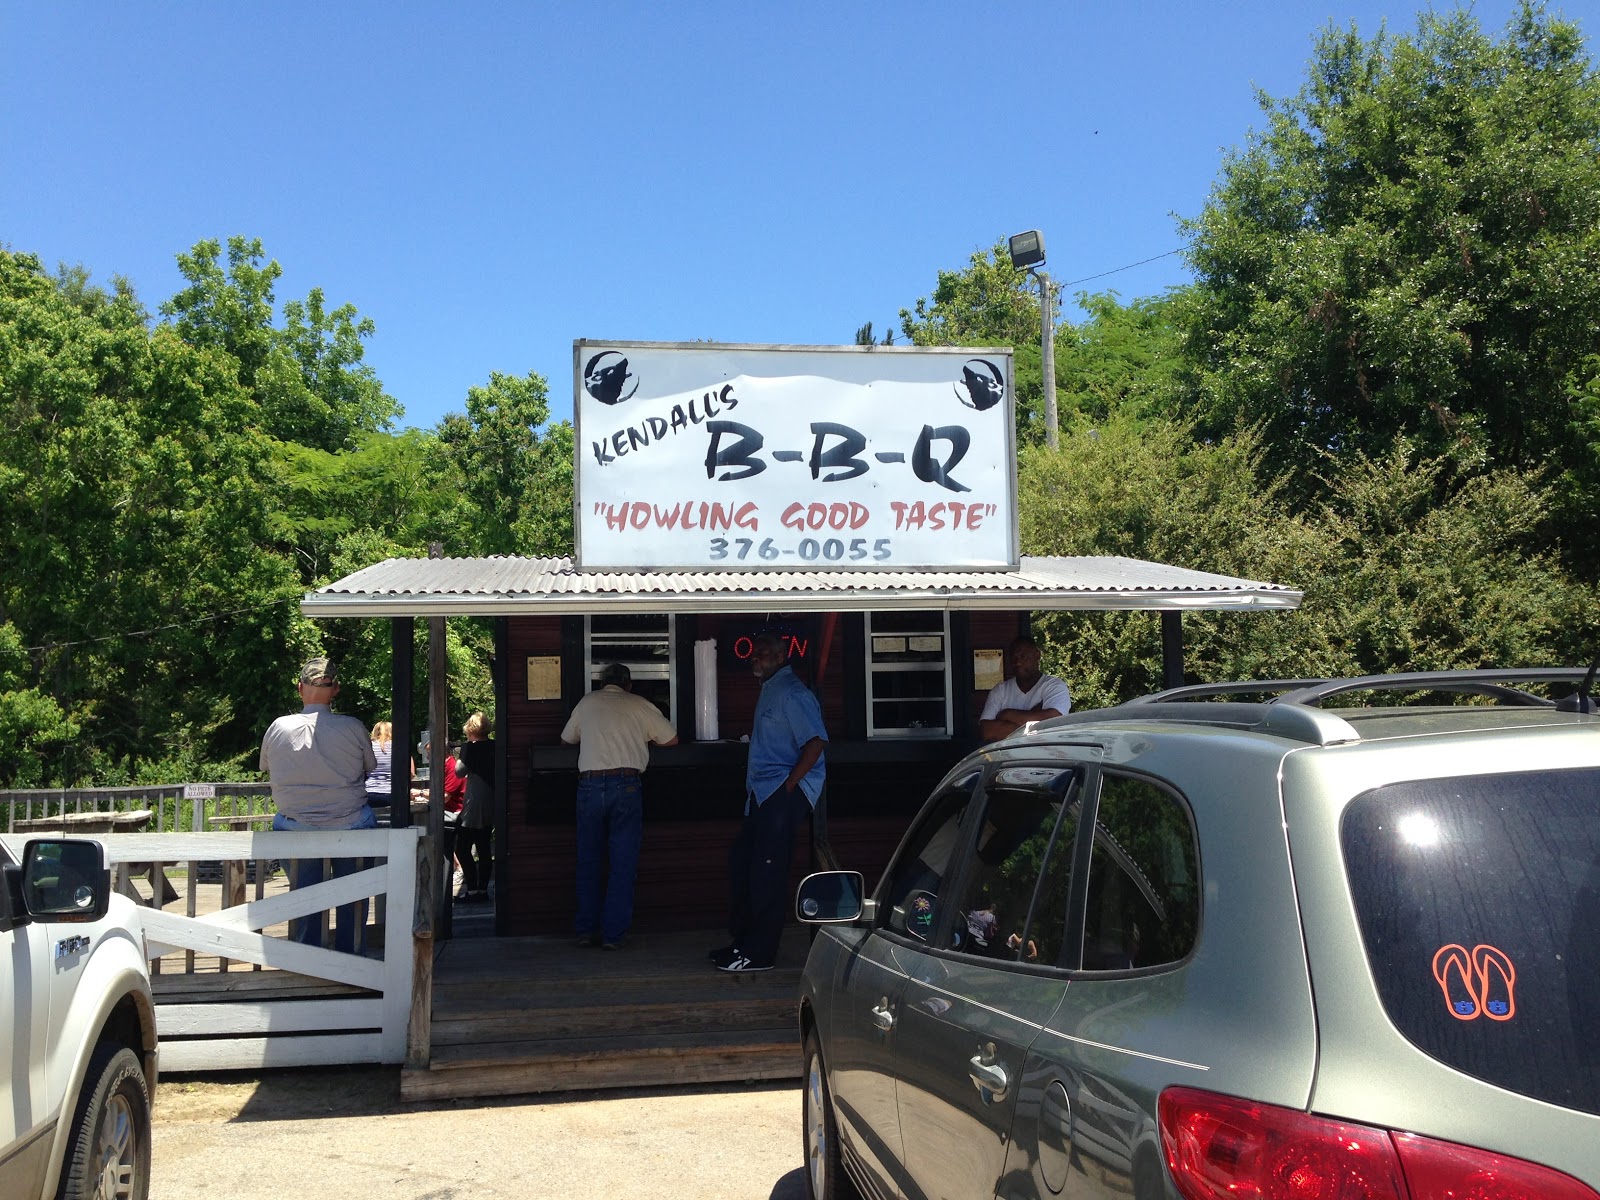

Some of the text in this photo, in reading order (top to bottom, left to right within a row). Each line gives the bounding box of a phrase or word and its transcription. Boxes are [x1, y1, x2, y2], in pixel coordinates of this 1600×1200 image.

[592, 384, 739, 466] KENDALL'S
[704, 420, 972, 493] B-B-Q
[593, 501, 998, 532] "HOWLING GOOD TASTE"
[708, 537, 892, 562] 376-0055
[734, 636, 808, 658] ON
